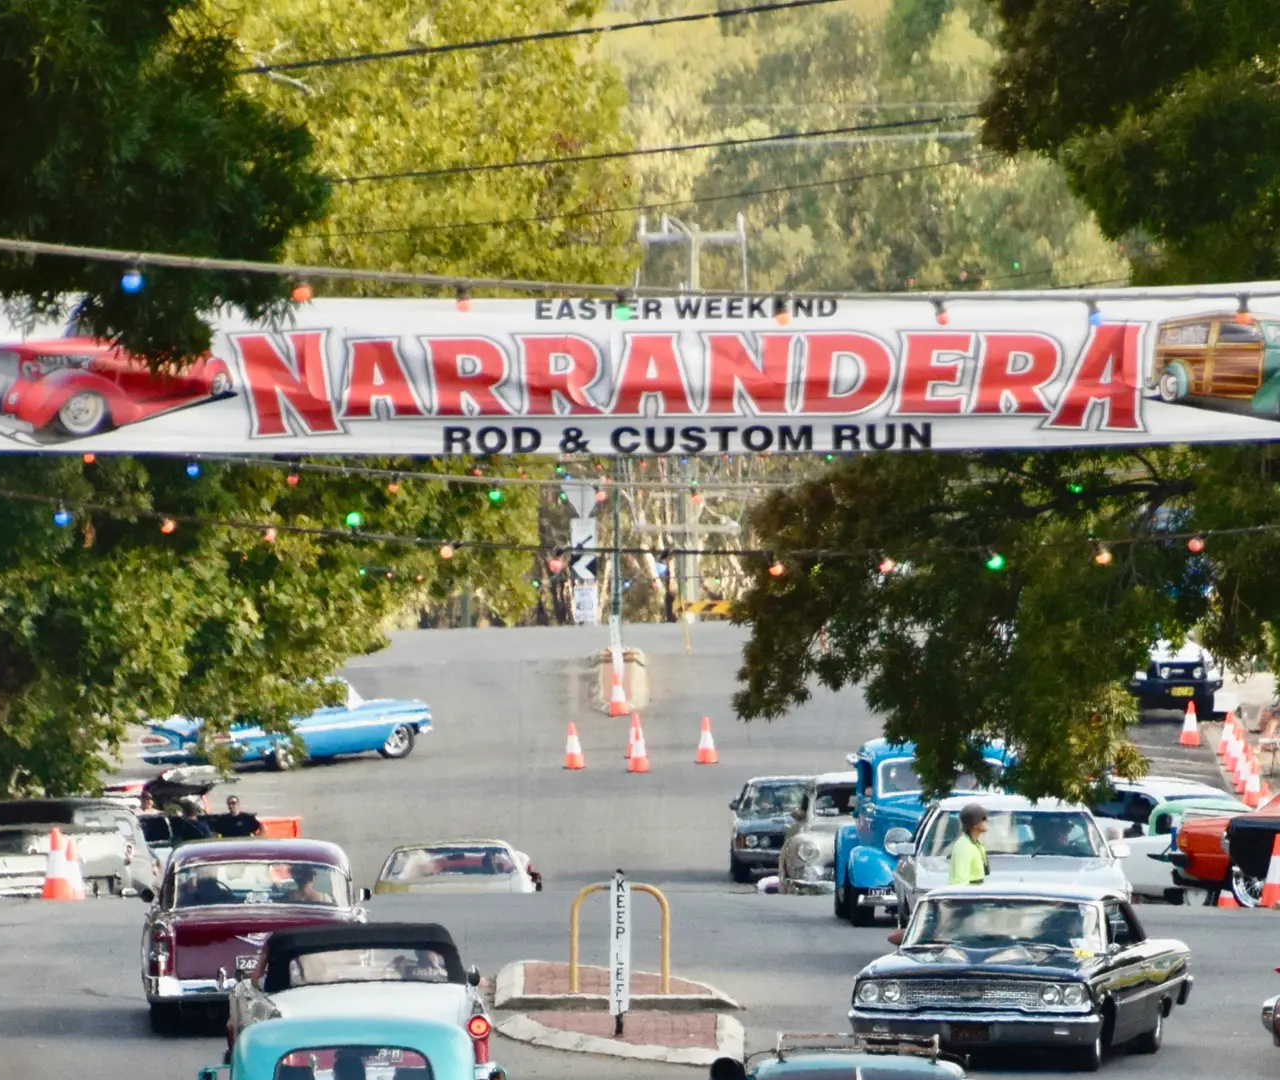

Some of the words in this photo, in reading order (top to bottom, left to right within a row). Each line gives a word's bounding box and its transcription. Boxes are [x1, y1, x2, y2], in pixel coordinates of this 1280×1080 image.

[228, 320, 1150, 438] NARRANDERA
[443, 426, 541, 454] ROD
[560, 426, 589, 453] &
[611, 424, 812, 453] CUSTOM
[833, 422, 933, 450] RUN
[615, 879, 626, 940] KEEP
